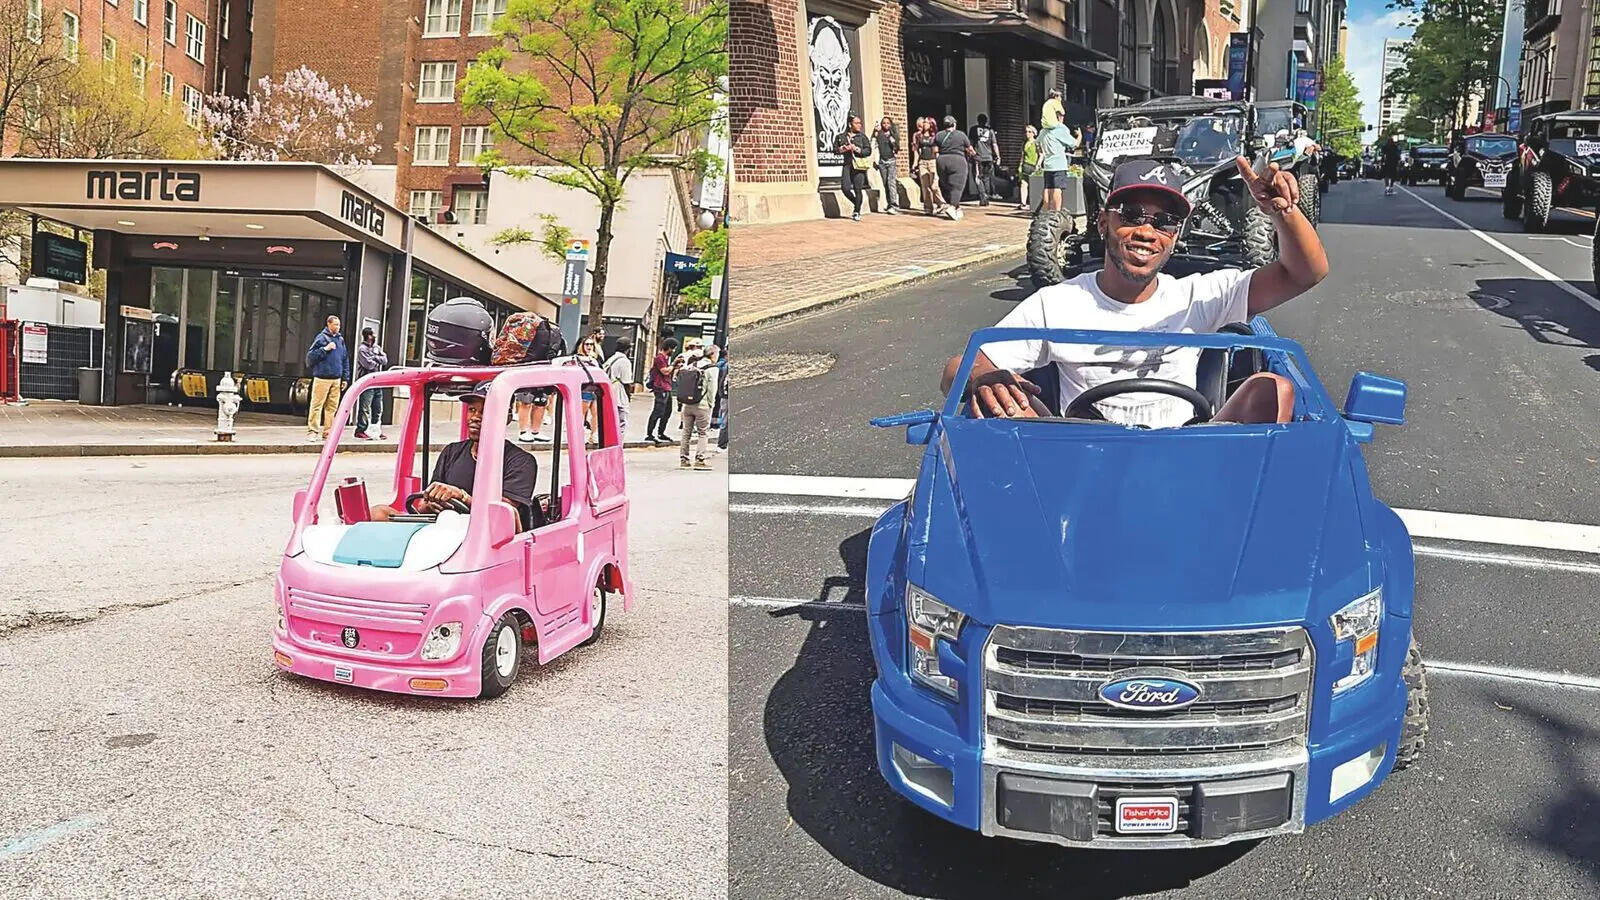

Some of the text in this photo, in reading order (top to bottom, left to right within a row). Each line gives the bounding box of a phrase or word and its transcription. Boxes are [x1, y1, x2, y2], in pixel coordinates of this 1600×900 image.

[1101, 139, 1153, 149] DICKENS
[1104, 132, 1144, 142] ANDRE
[87, 168, 201, 202] marta
[1139, 165, 1168, 185] A
[341, 190, 386, 237] marta
[572, 273, 581, 295] Center
[1120, 681, 1180, 703] Ford
[1124, 808, 1169, 817] Fisher-Price
